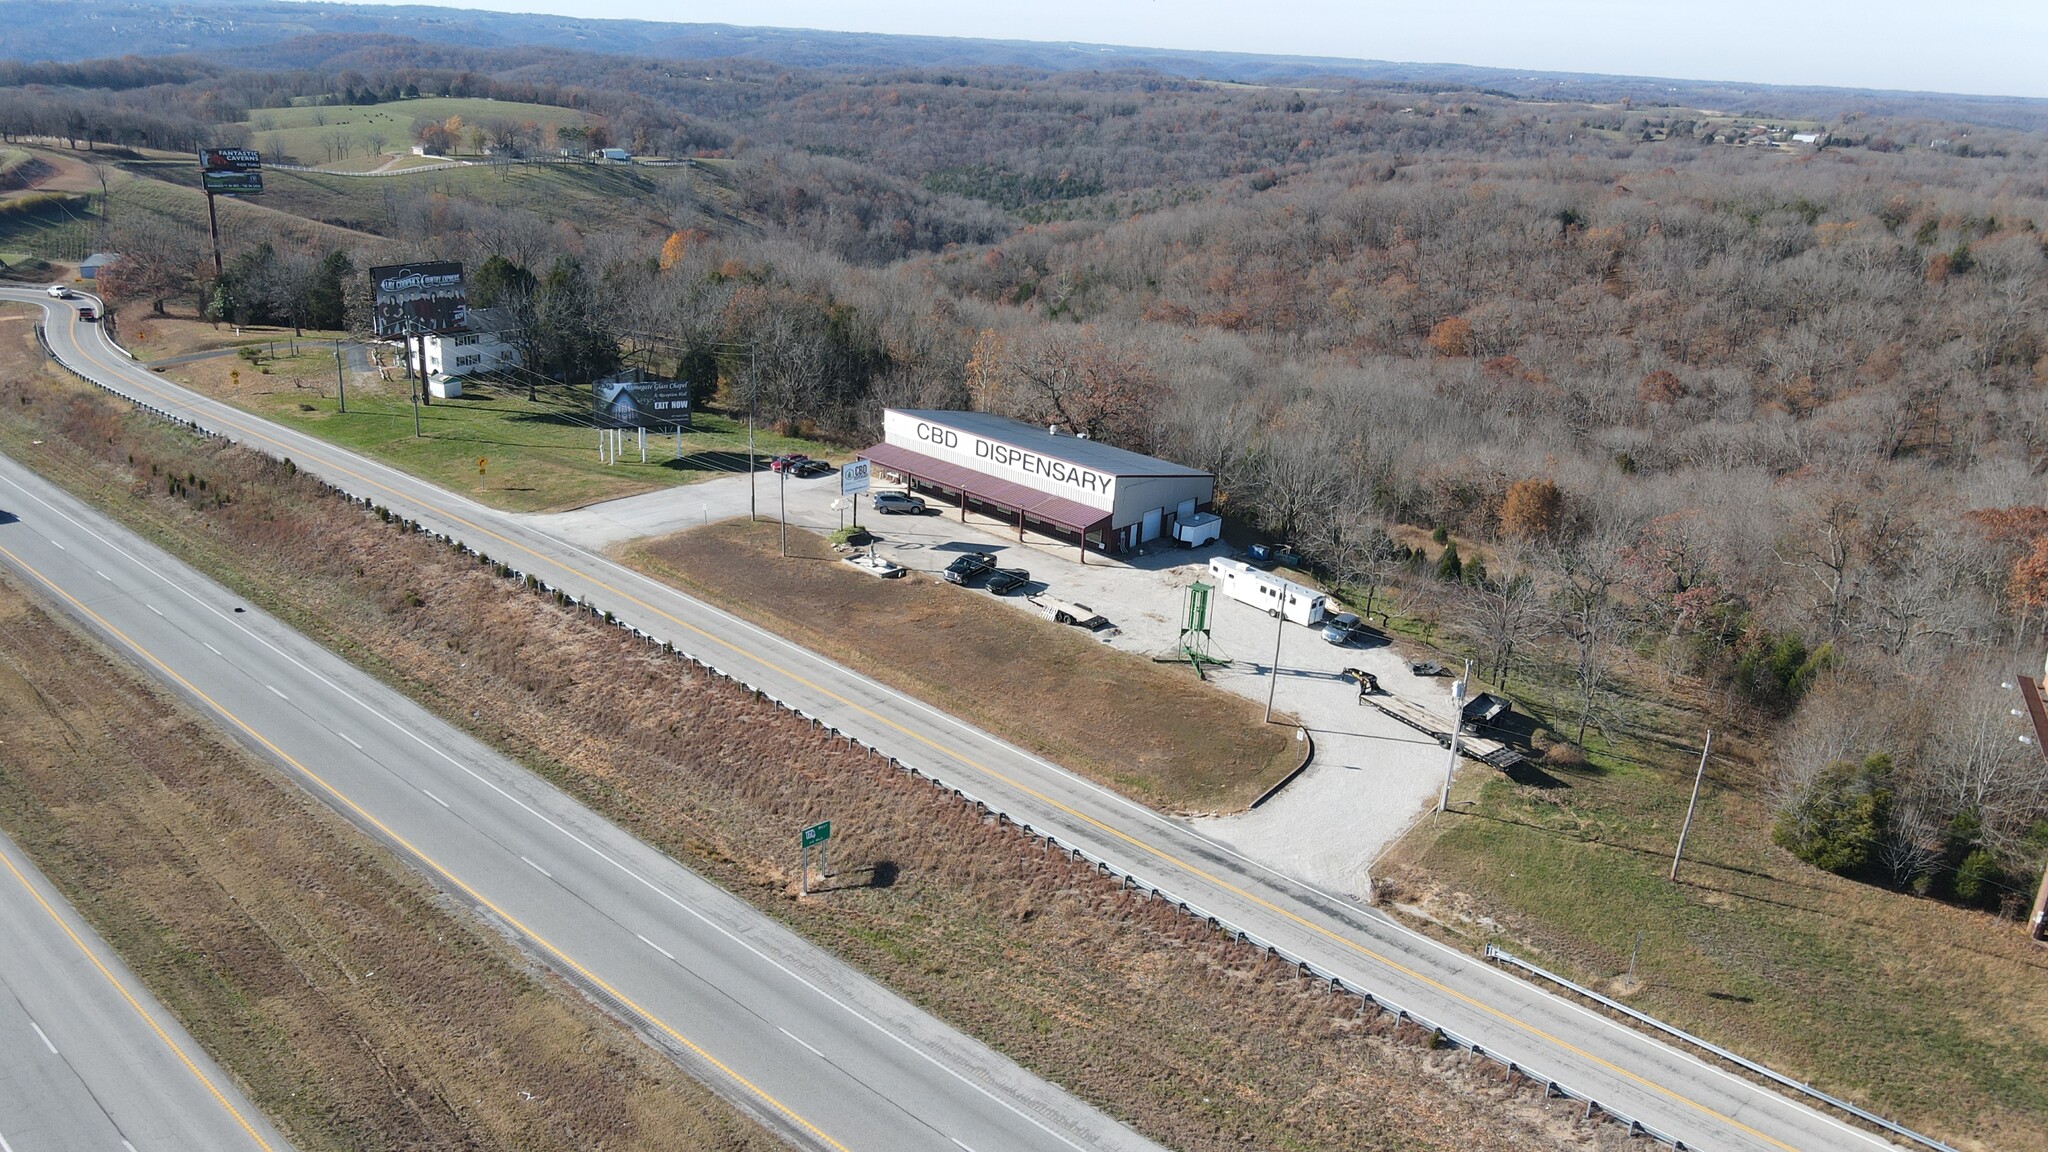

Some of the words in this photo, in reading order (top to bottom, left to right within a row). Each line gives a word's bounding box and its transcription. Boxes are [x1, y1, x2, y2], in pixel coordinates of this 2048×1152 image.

[669, 381, 689, 390] Chapel
[654, 401, 669, 410] EXIT
[671, 400, 688, 409] NOW
[917, 422, 958, 448] CBD
[975, 439, 1112, 495] DISPENSARY
[854, 464, 868, 476] CBD
